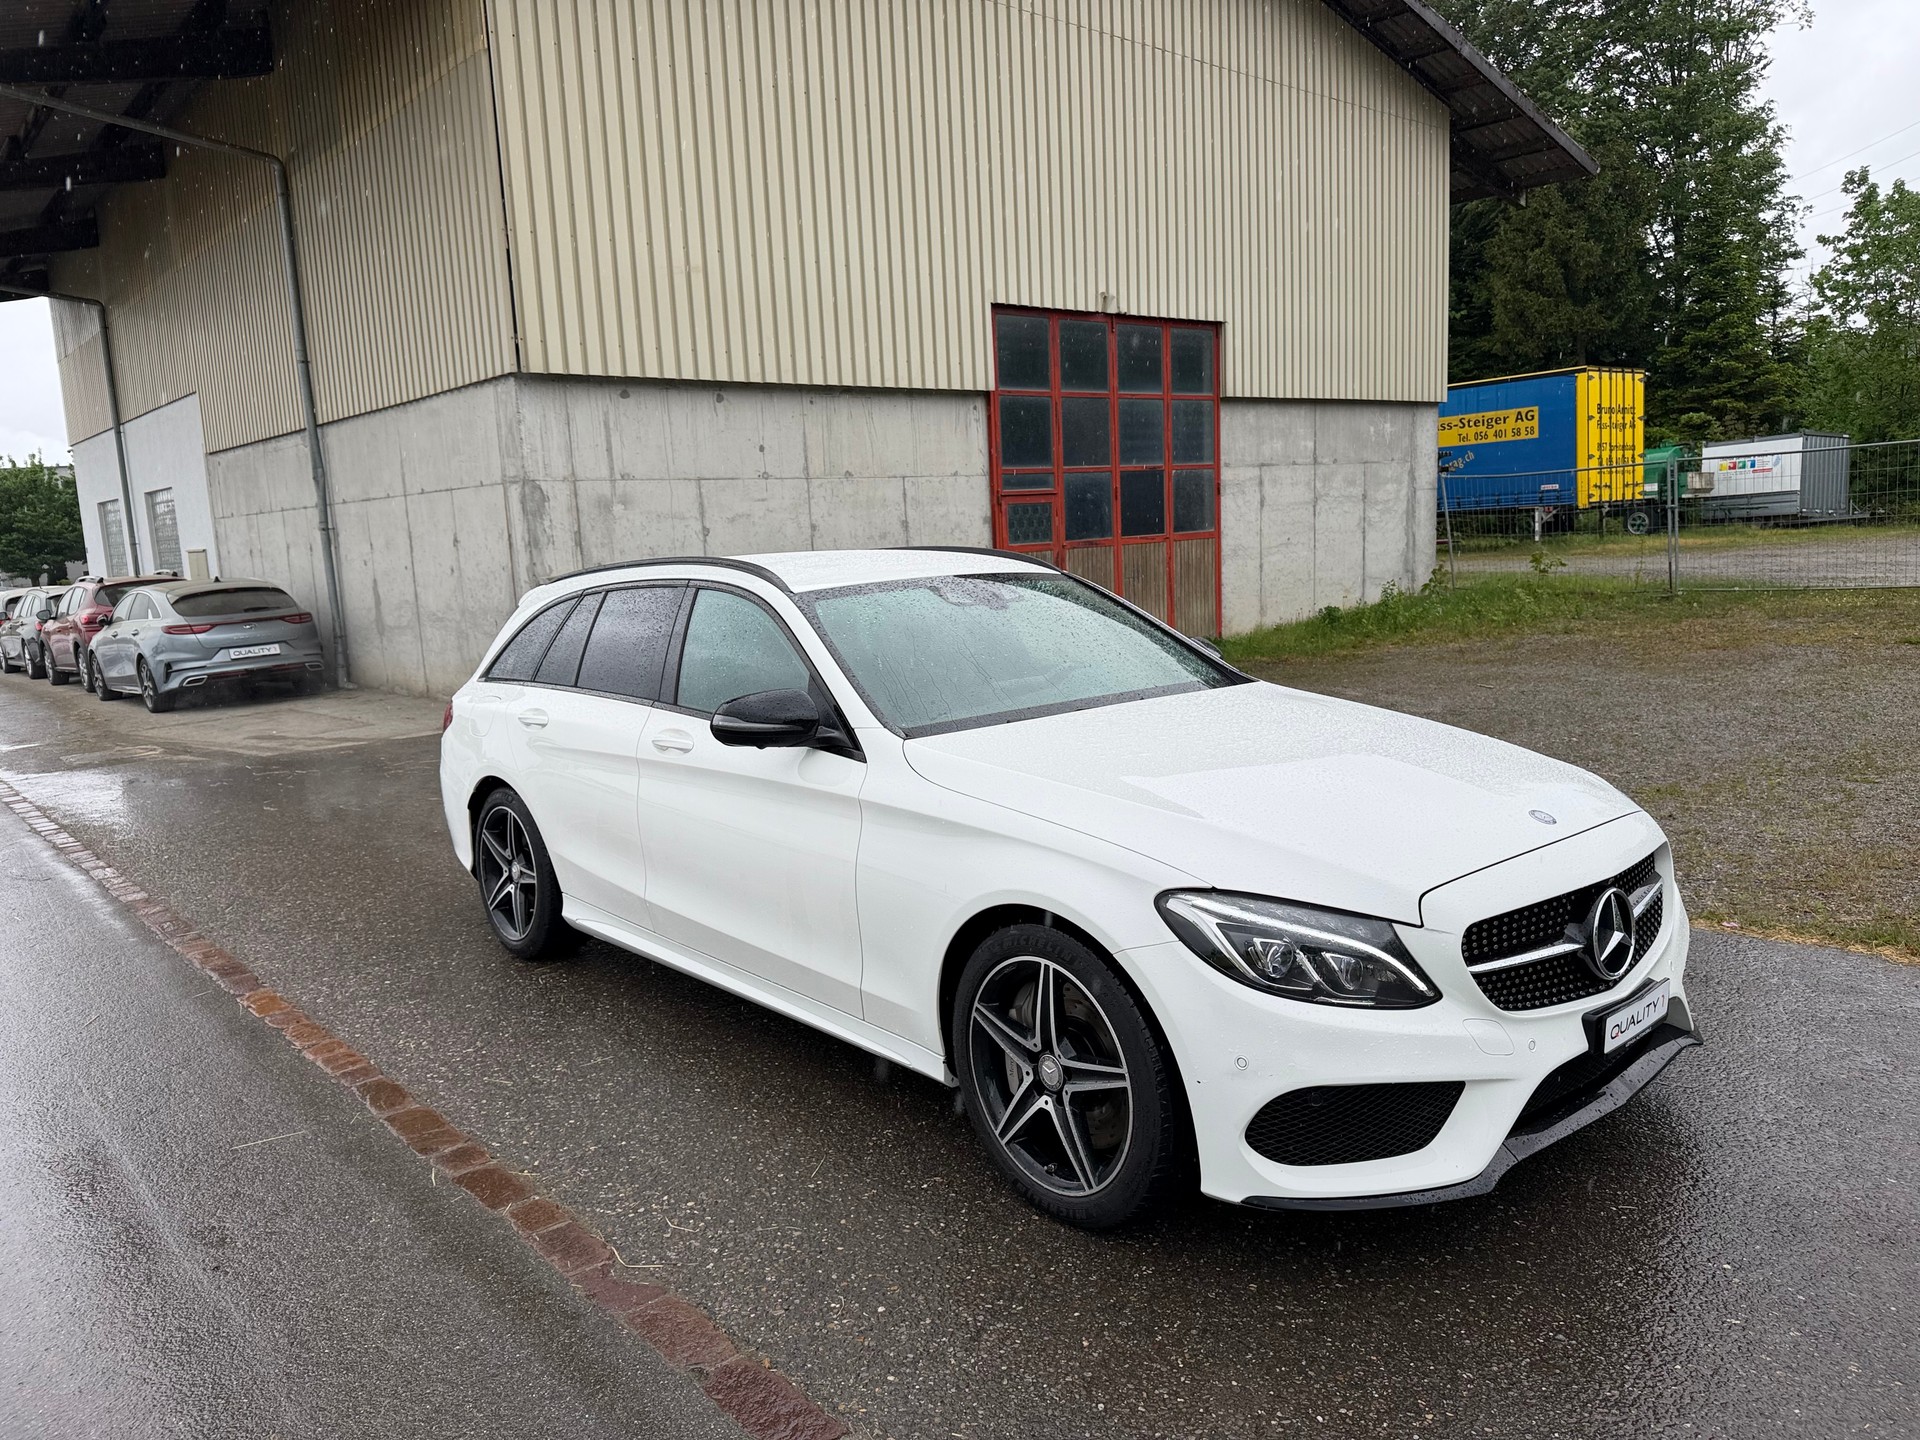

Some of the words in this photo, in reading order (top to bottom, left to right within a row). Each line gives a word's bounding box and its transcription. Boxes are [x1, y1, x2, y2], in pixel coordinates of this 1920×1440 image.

[1438, 415, 1510, 431] ss-Steiger
[1514, 409, 1535, 423] AG
[1457, 433, 1471, 443] Tel.
[1473, 430, 1489, 442] 056
[1493, 428, 1507, 440] 401
[1511, 427, 1522, 438] 58
[1525, 425, 1535, 437] 58
[233, 647, 271, 656] QUALITY
[1610, 997, 1660, 1040] QUALITY
[1661, 994, 1665, 1008] 1
